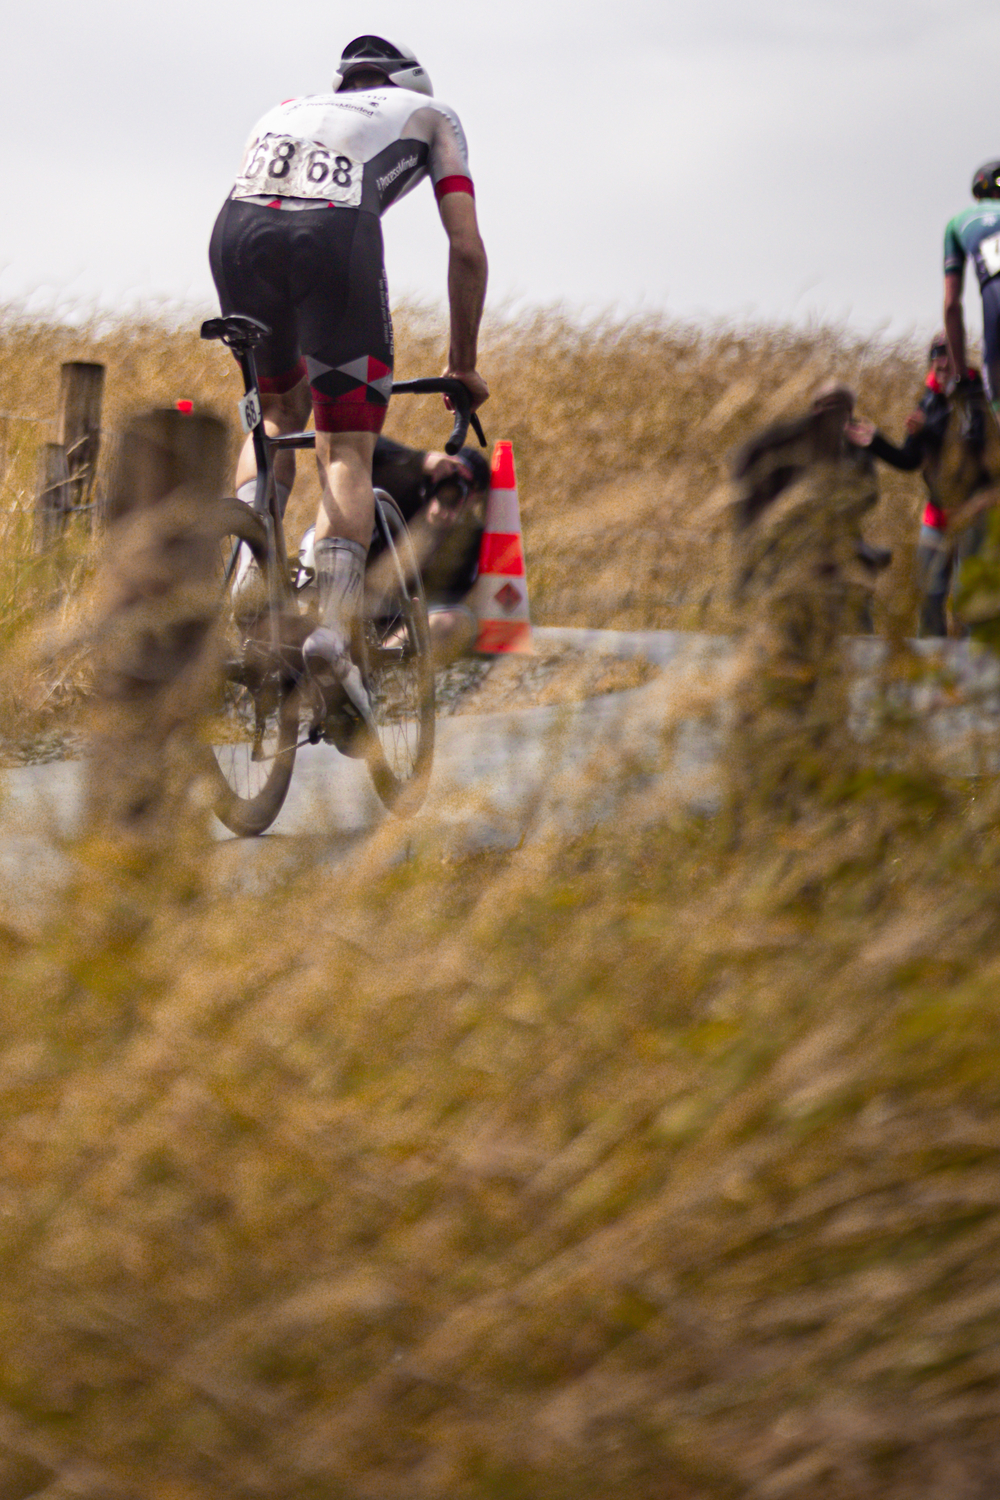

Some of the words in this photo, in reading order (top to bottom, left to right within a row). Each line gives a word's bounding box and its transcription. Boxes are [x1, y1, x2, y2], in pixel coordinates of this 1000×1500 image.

[245, 142, 296, 179] 68
[307, 150, 353, 188] 68
[245, 400, 257, 429] 68
